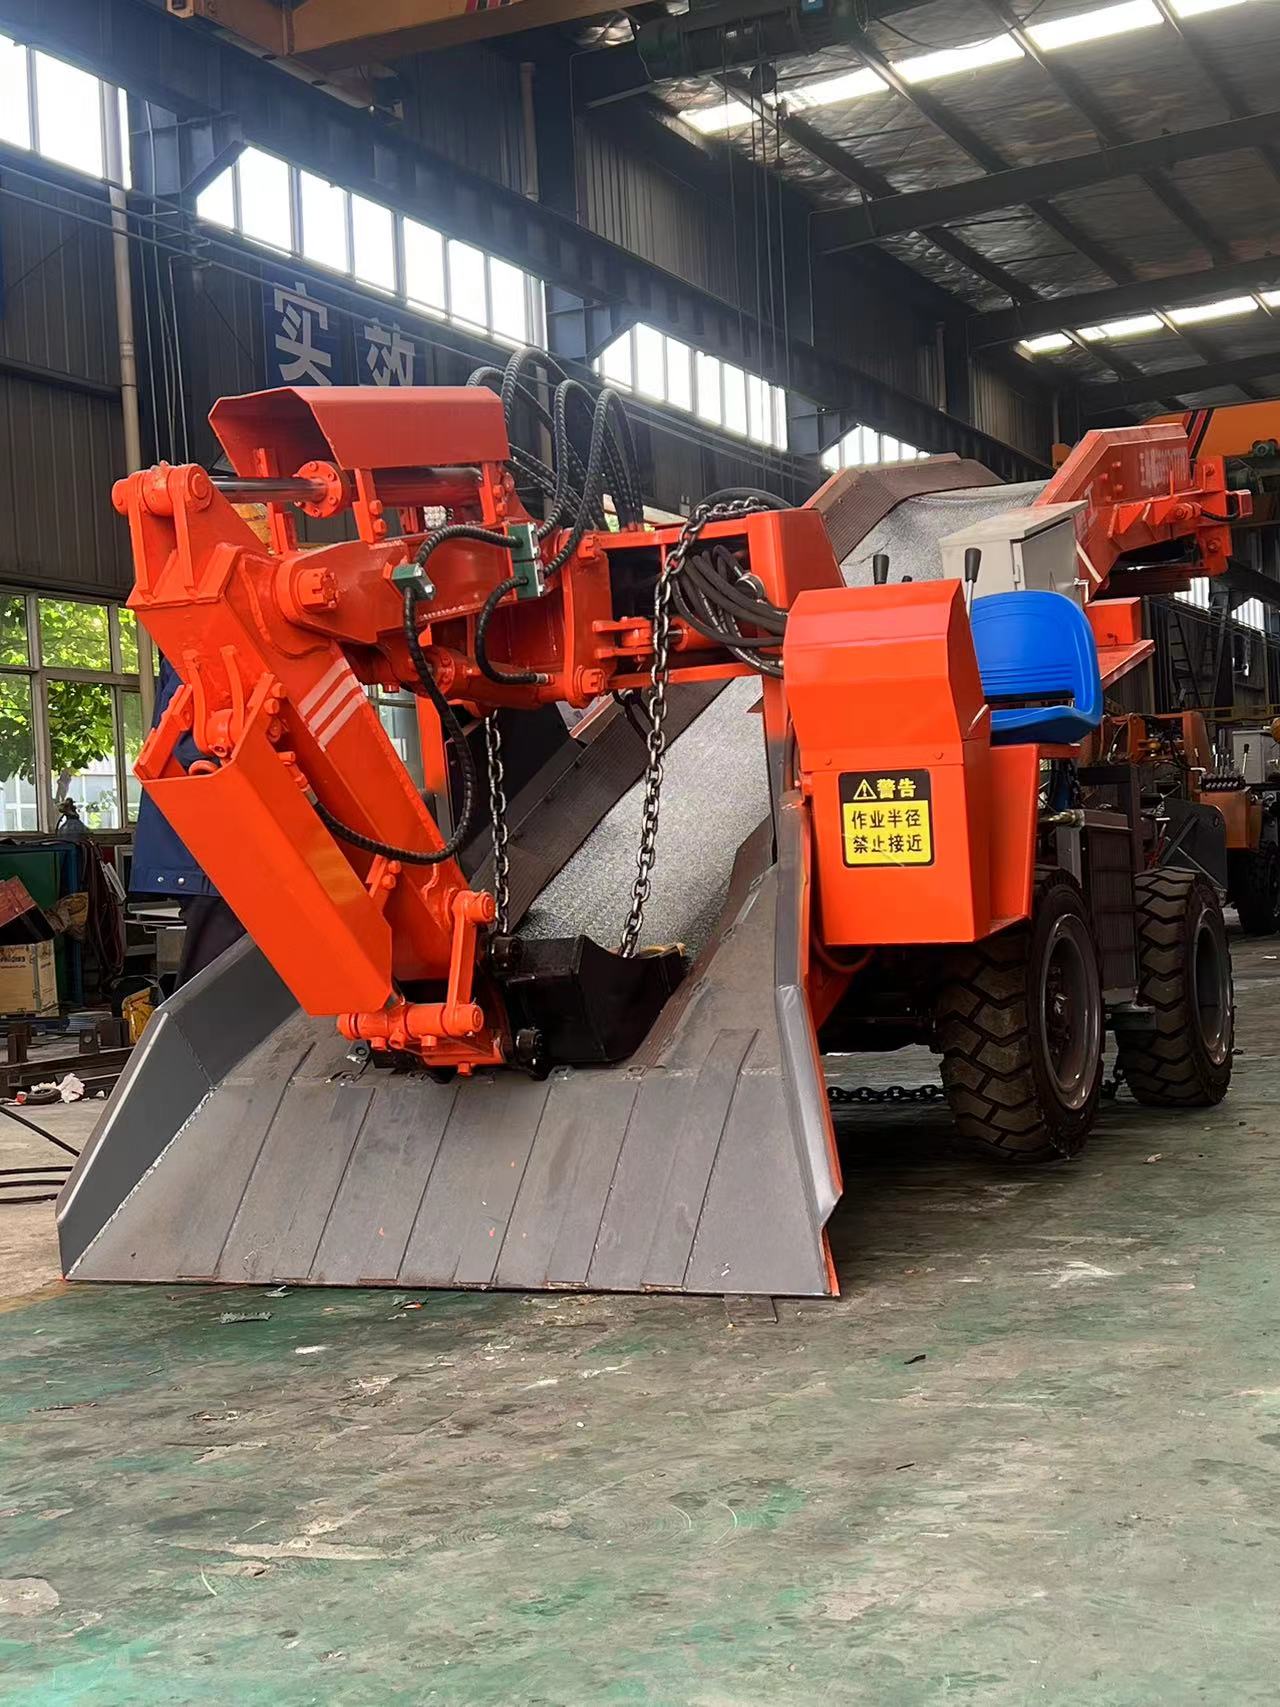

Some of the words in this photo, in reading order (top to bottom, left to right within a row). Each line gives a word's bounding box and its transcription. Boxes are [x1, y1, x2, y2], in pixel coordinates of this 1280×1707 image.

[274, 282, 416, 386] 实效
[877, 778, 917, 799] 警告
[851, 809, 922, 829] 作业半径
[853, 834, 923, 854] 禁止接近
